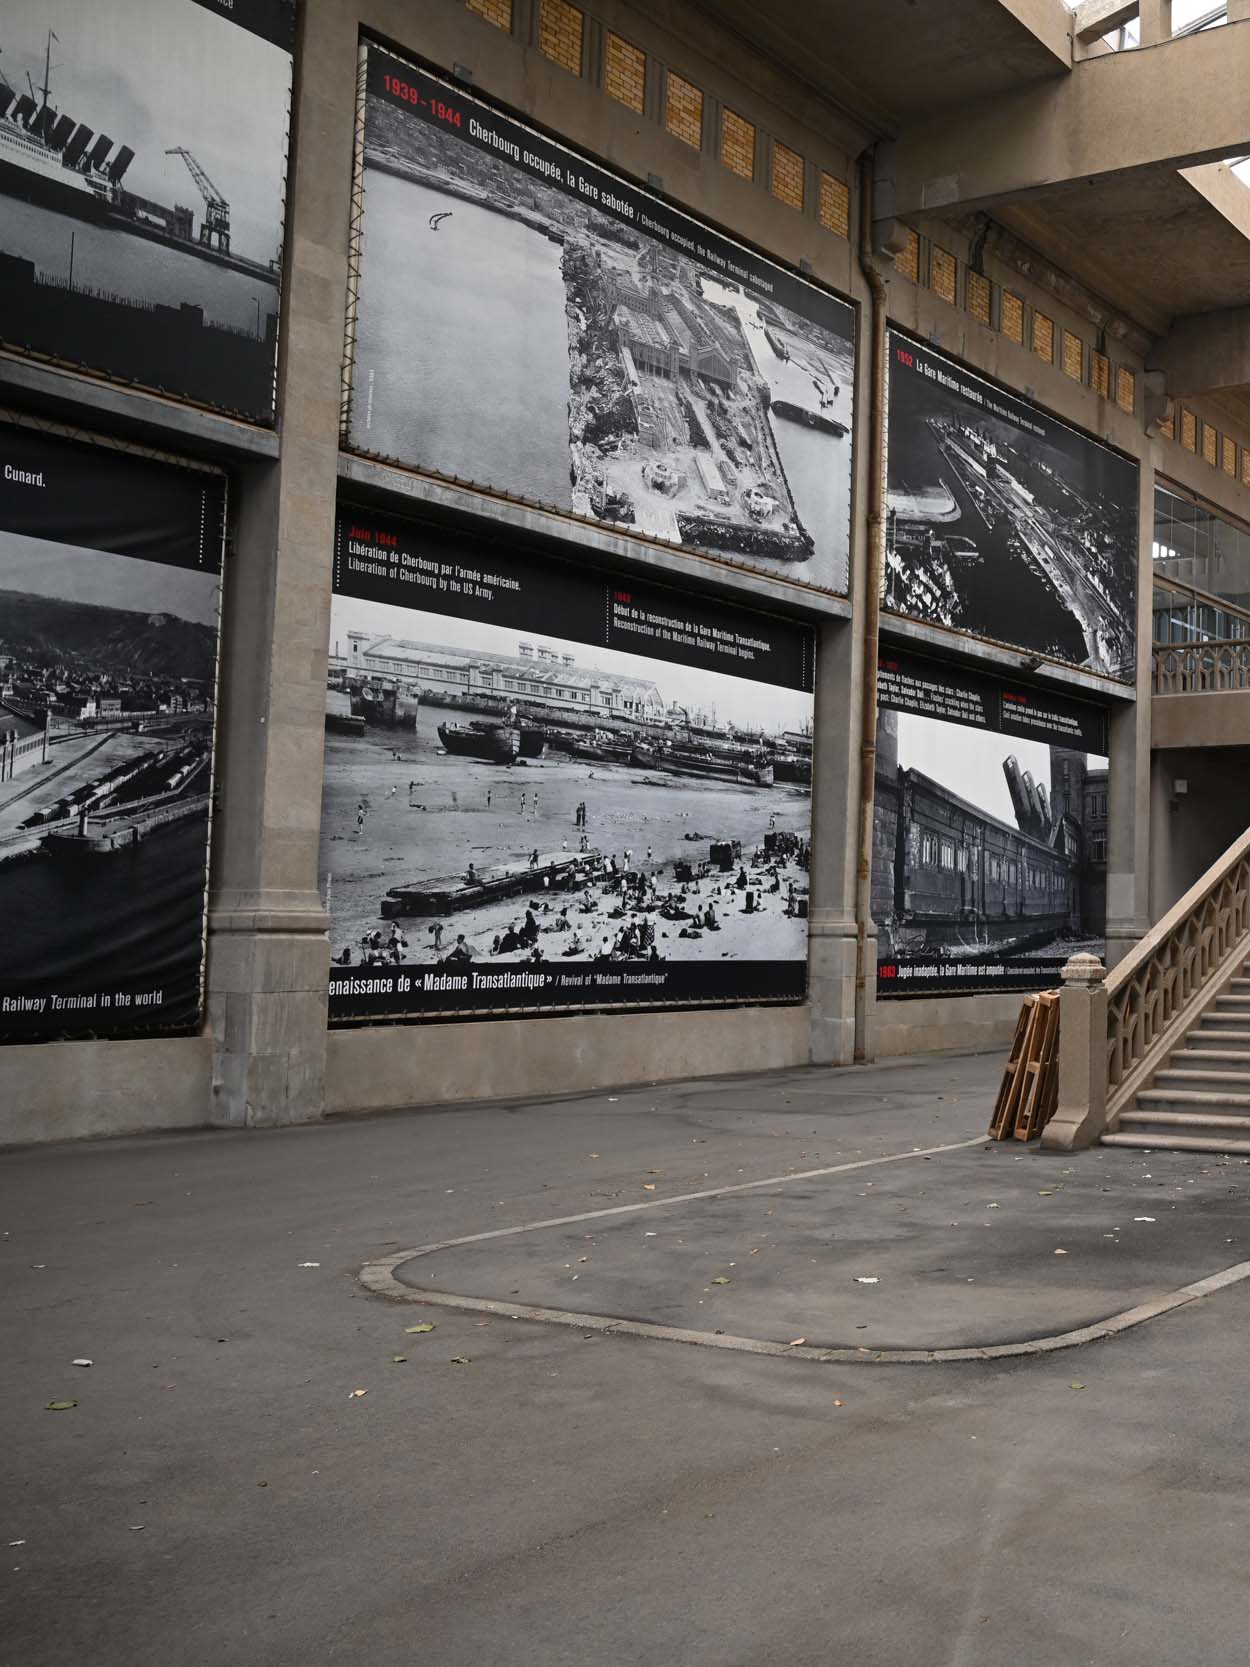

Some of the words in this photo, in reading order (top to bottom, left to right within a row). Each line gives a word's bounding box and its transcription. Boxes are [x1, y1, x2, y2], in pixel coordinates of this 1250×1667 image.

[469, 118, 520, 162] Cherbourg
[523, 150, 564, 184] occupée,
[567, 170, 576, 188] la
[578, 176, 599, 200] Gare
[601, 191, 634, 219] sabotée
[641, 214, 670, 239] Cherbourg
[697, 244, 706, 257] the
[706, 249, 727, 269] Railway
[727, 260, 749, 280] Terminal
[749, 273, 774, 293] sabotaged
[916, 359, 923, 373] La
[924, 363, 937, 380] Gare
[937, 369, 960, 392] Maritime
[960, 384, 983, 404] restaurée
[4, 464, 46, 488] Cunard.
[348, 540, 387, 560] Libération
[390, 550, 399, 563] de
[401, 553, 438, 574] Cherbourg
[441, 564, 453, 576] par
[483, 573, 521, 591] américaine.
[348, 557, 387, 577] Liberation
[390, 567, 397, 578] of
[400, 568, 437, 589] Cherbourg
[440, 577, 448, 591] by
[450, 579, 461, 592] the
[463, 582, 473, 595] US
[475, 585, 494, 601] Army.
[613, 603, 630, 617] Début
[631, 607, 638, 619] de
[640, 609, 645, 620] la
[646, 613, 684, 630] reconstruction
[685, 621, 692, 632] de
[693, 623, 698, 633] la
[700, 624, 711, 637] Gare
[712, 627, 734, 642] Maritime
[613, 616, 654, 636] Reconstruction
[655, 627, 661, 637] of
[662, 629, 671, 640] the
[672, 631, 696, 645] Maritime
[696, 636, 716, 652] Railway
[717, 641, 738, 656] Terminal
[398, 974, 411, 992] de
[561, 974, 583, 986] Revival
[585, 974, 592, 986] of
[940, 963, 945, 976] la
[945, 963, 957, 976] Gare
[957, 963, 978, 976] Maritime
[2, 996, 47, 1013] Railway
[50, 993, 97, 1010] Terminal
[100, 992, 111, 1008] in
[115, 991, 131, 1007] the
[135, 990, 163, 1006] world
